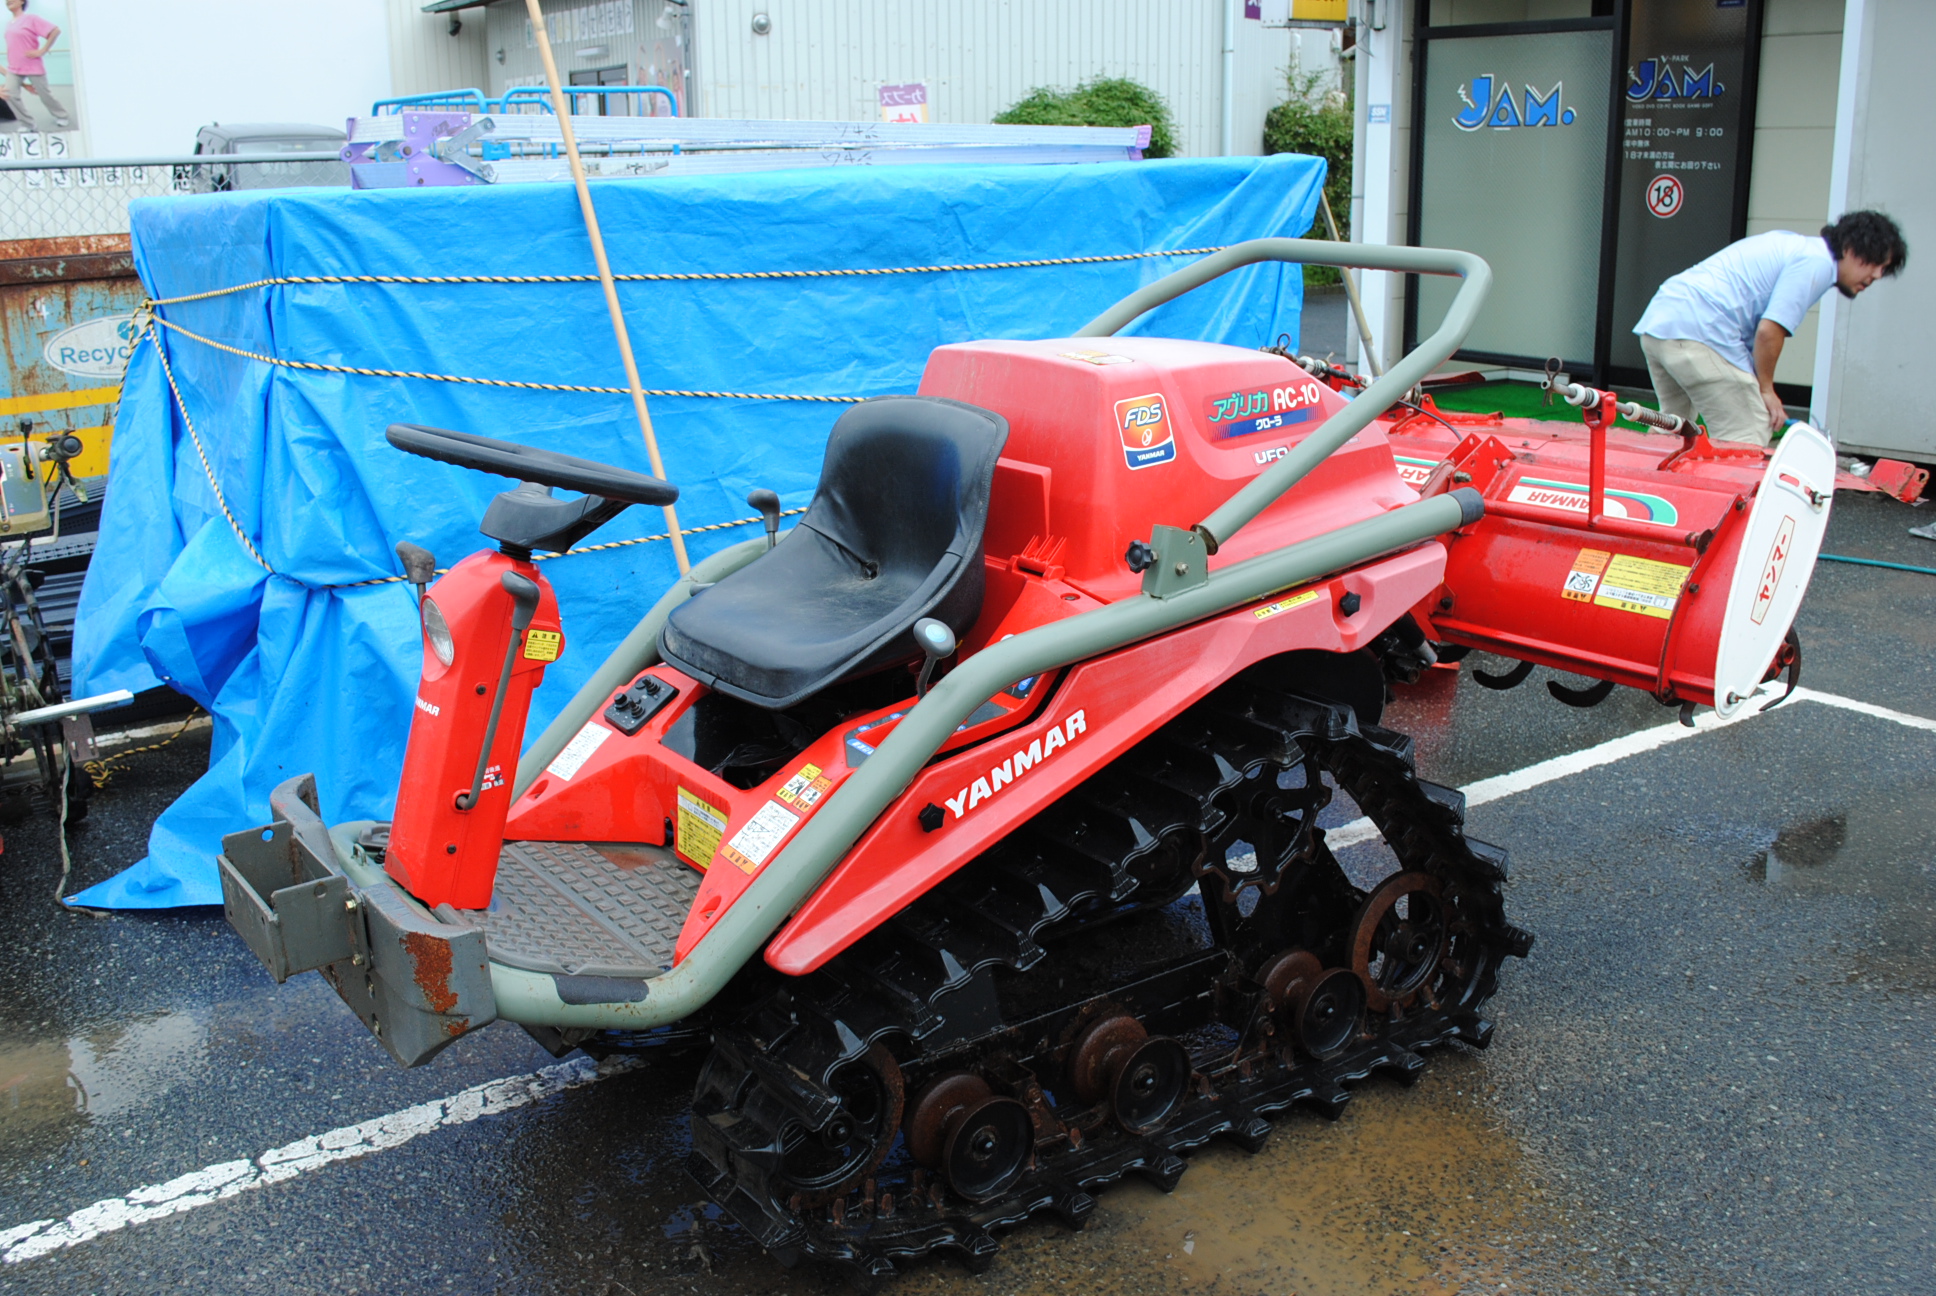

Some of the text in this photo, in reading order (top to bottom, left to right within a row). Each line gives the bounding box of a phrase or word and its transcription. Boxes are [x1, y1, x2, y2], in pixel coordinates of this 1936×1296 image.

[1124, 403, 1163, 429] FDS
[1208, 390, 1269, 423] アグリカ
[1136, 449, 1166, 462] YANMAR
[1759, 533, 1788, 603] ヤンマー
[944, 709, 1087, 819] YANMAR
